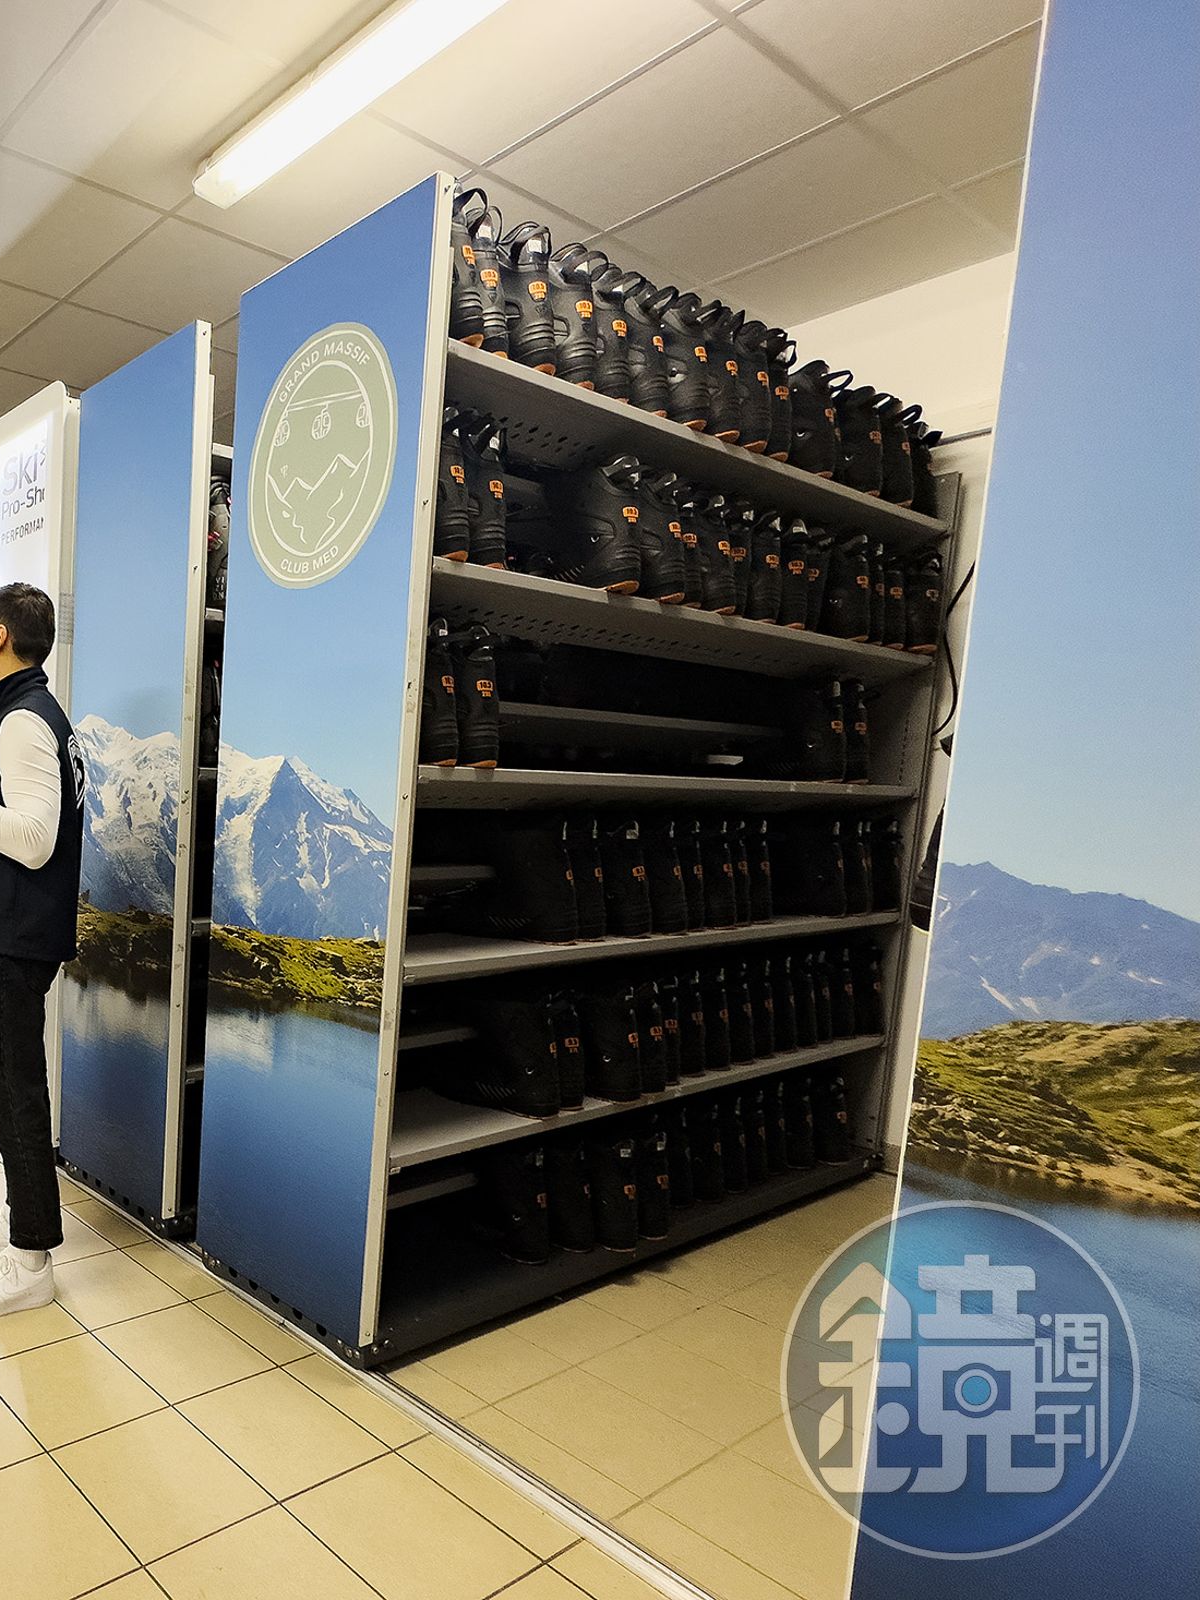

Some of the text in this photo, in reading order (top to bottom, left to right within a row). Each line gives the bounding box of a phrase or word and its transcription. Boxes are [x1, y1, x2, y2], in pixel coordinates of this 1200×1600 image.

[279, 340, 371, 402] GRAND MASSIF
[280, 545, 339, 574] CLUB MED
